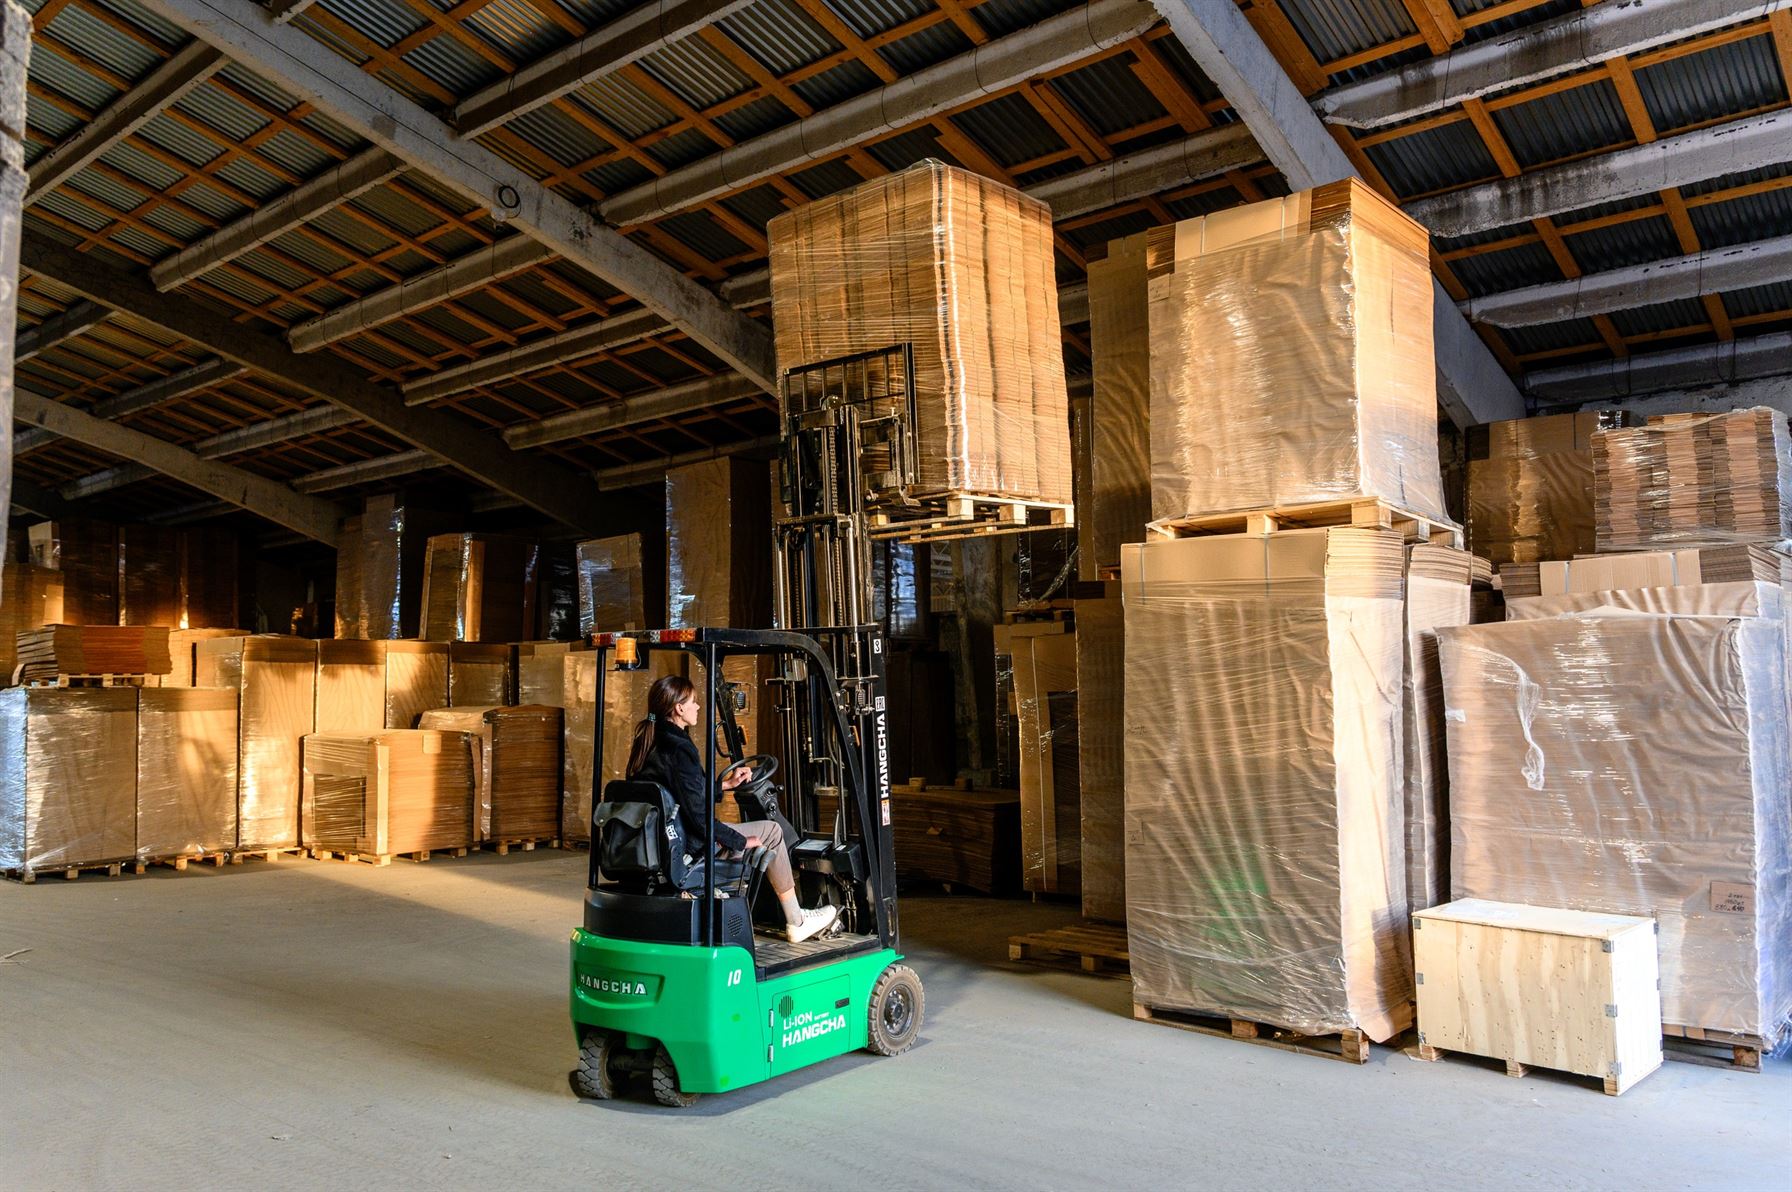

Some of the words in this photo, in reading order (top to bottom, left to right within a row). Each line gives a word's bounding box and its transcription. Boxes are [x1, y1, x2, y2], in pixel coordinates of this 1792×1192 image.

[877, 713, 889, 799] HANGCHA
[580, 974, 646, 994] HANGCHA
[728, 969, 742, 986] 10
[782, 1014, 846, 1048] HANGCHA
